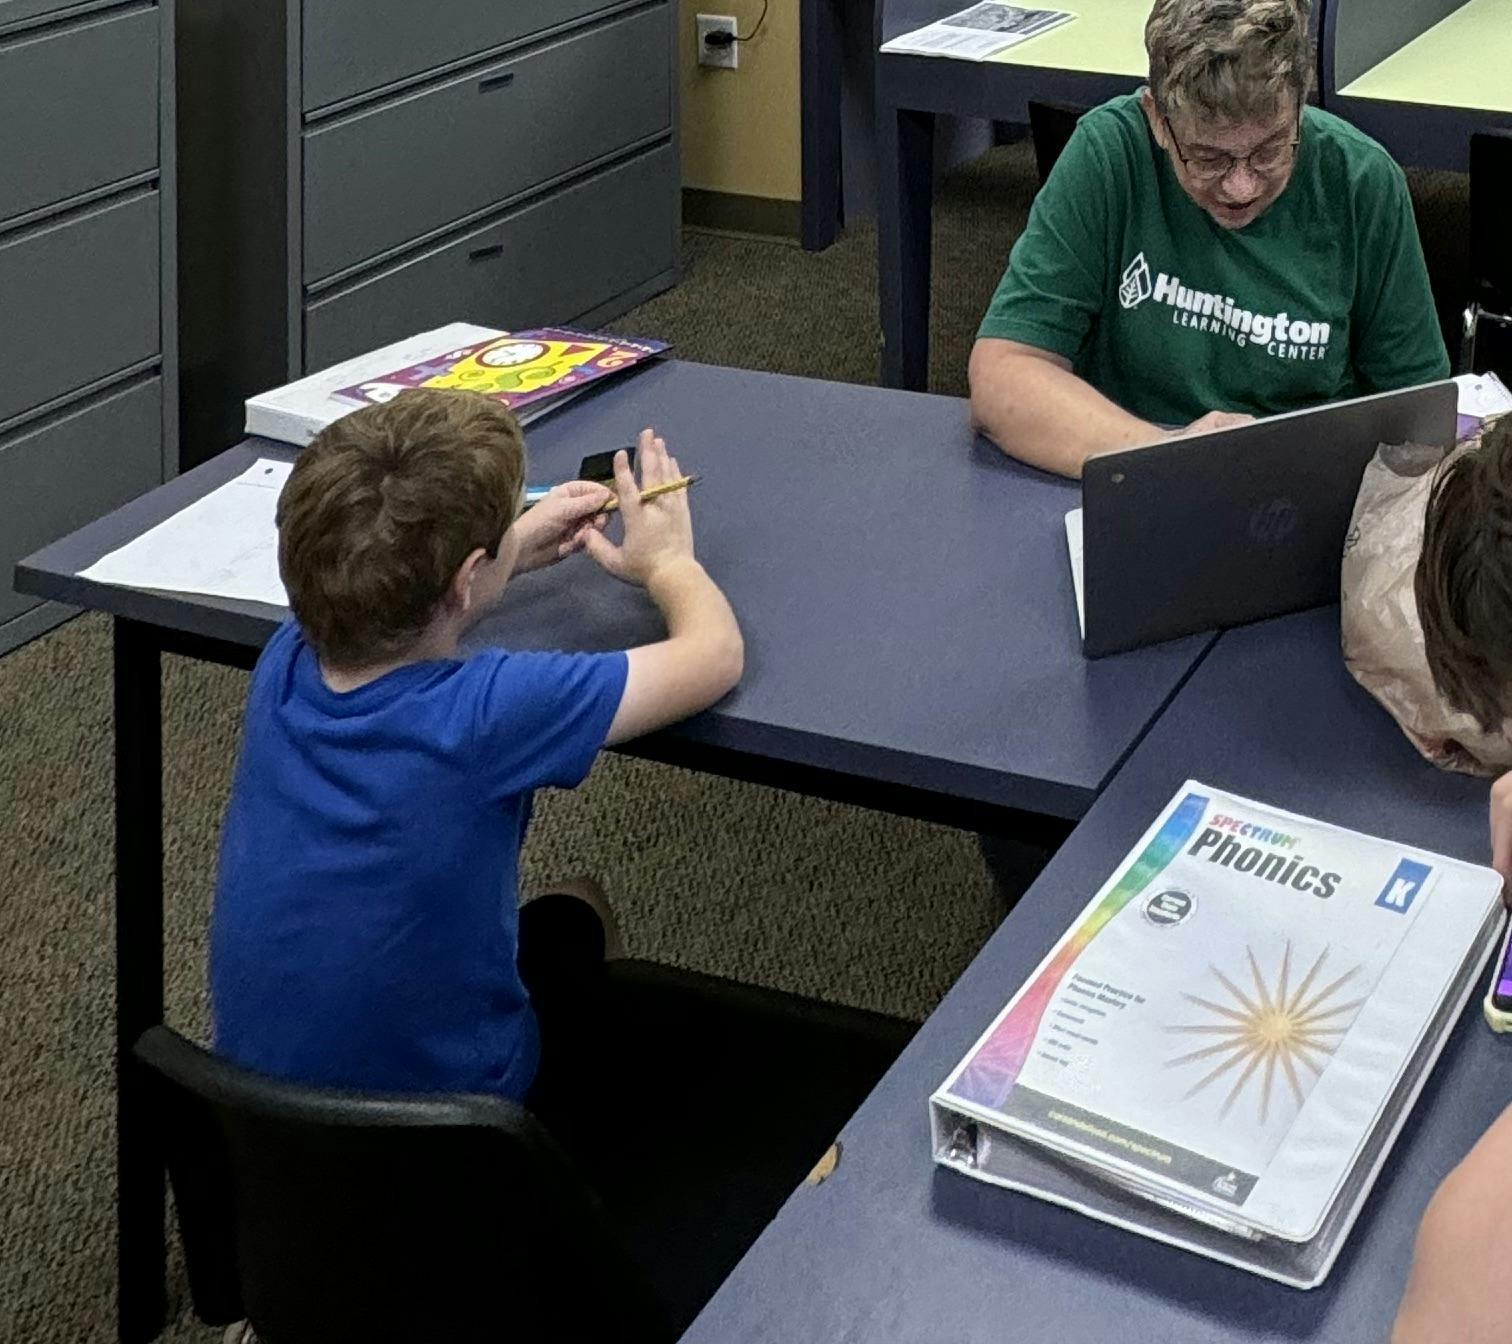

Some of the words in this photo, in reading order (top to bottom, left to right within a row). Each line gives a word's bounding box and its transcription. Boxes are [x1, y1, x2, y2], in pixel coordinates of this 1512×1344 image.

[1152, 272, 1331, 345] Huntington
[1172, 310, 1247, 348] LEARNING
[1266, 341, 1326, 360] CENTER
[1208, 814, 1298, 850] SPECTRUM
[1187, 827, 1342, 900] Phonics
[1385, 877, 1416, 907] K
